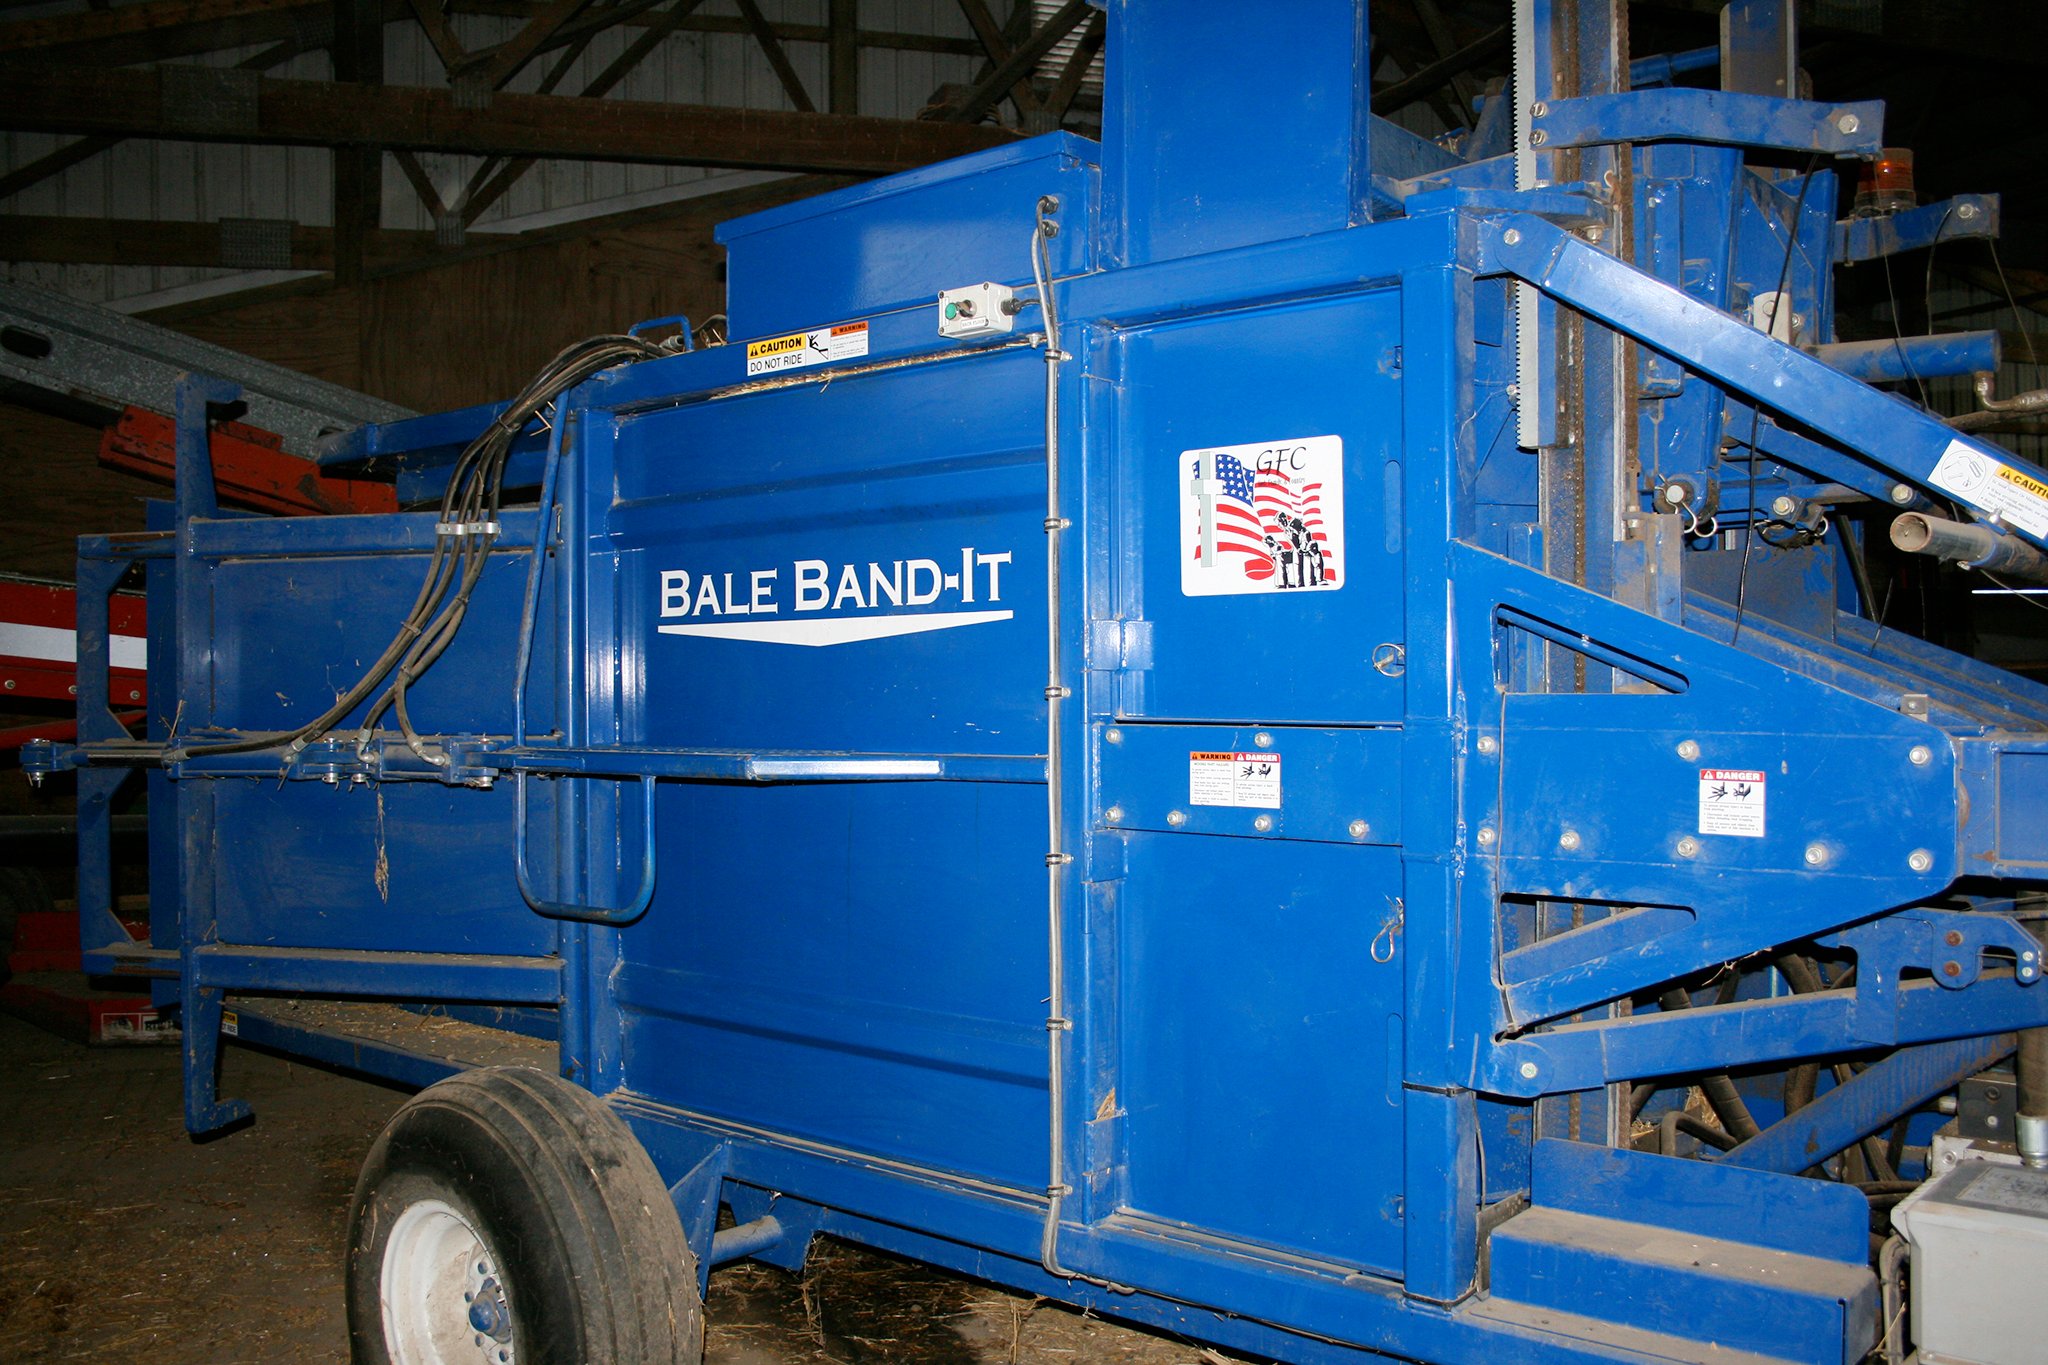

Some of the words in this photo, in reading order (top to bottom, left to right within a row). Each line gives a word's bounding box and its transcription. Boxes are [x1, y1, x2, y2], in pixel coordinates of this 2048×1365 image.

[839, 322, 867, 333] WARNING
[760, 337, 802, 354] CAUTION
[750, 361, 762, 373] DO
[764, 357, 780, 369] NOT
[783, 353, 803, 367] RIDE
[1256, 446, 1307, 476] GFC
[2013, 475, 2048, 499] CAUTI
[659, 567, 779, 618] BALE
[793, 547, 1012, 612] BAND-IT
[1245, 753, 1278, 762] DANGER
[1715, 771, 1761, 781] DANGER
